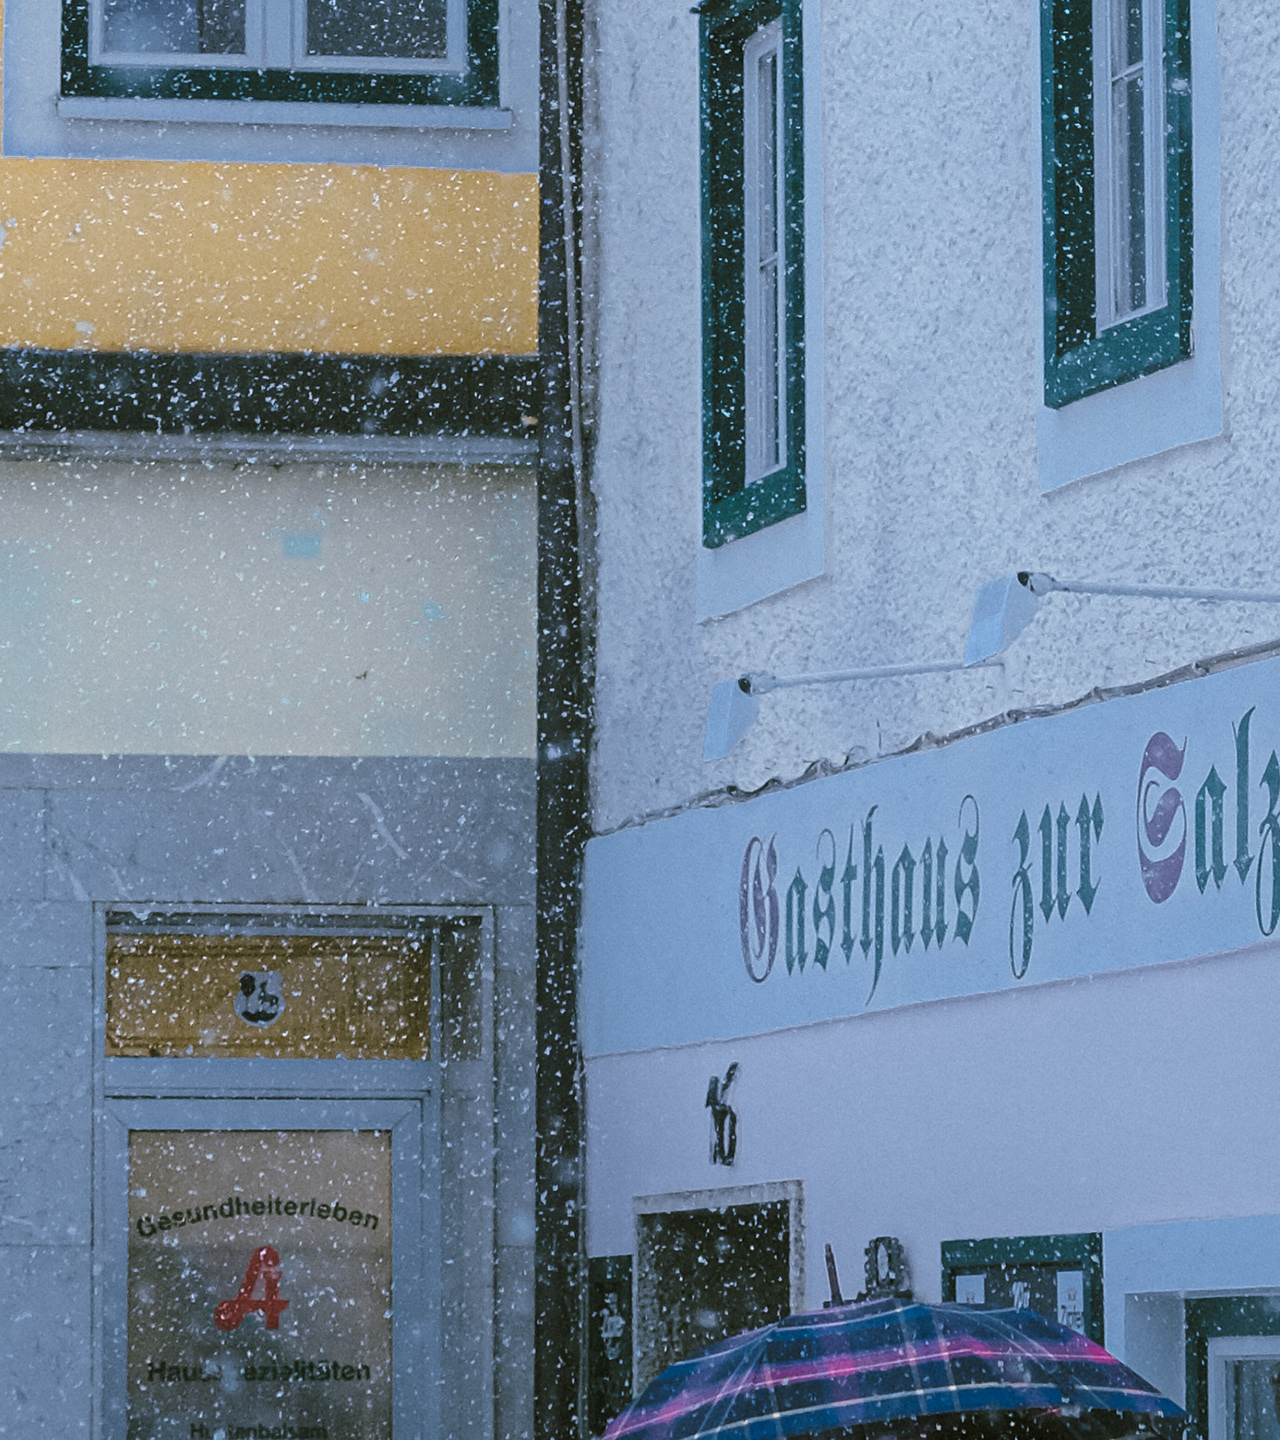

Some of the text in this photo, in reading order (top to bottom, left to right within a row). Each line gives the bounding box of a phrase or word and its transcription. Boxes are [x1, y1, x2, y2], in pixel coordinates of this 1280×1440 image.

[740, 794, 982, 1007] Gasthaus
[1010, 789, 1106, 979] zur
[146, 1360, 371, 1383] Hauezialitäten
[189, 1423, 328, 1440] Hutenbalsam
